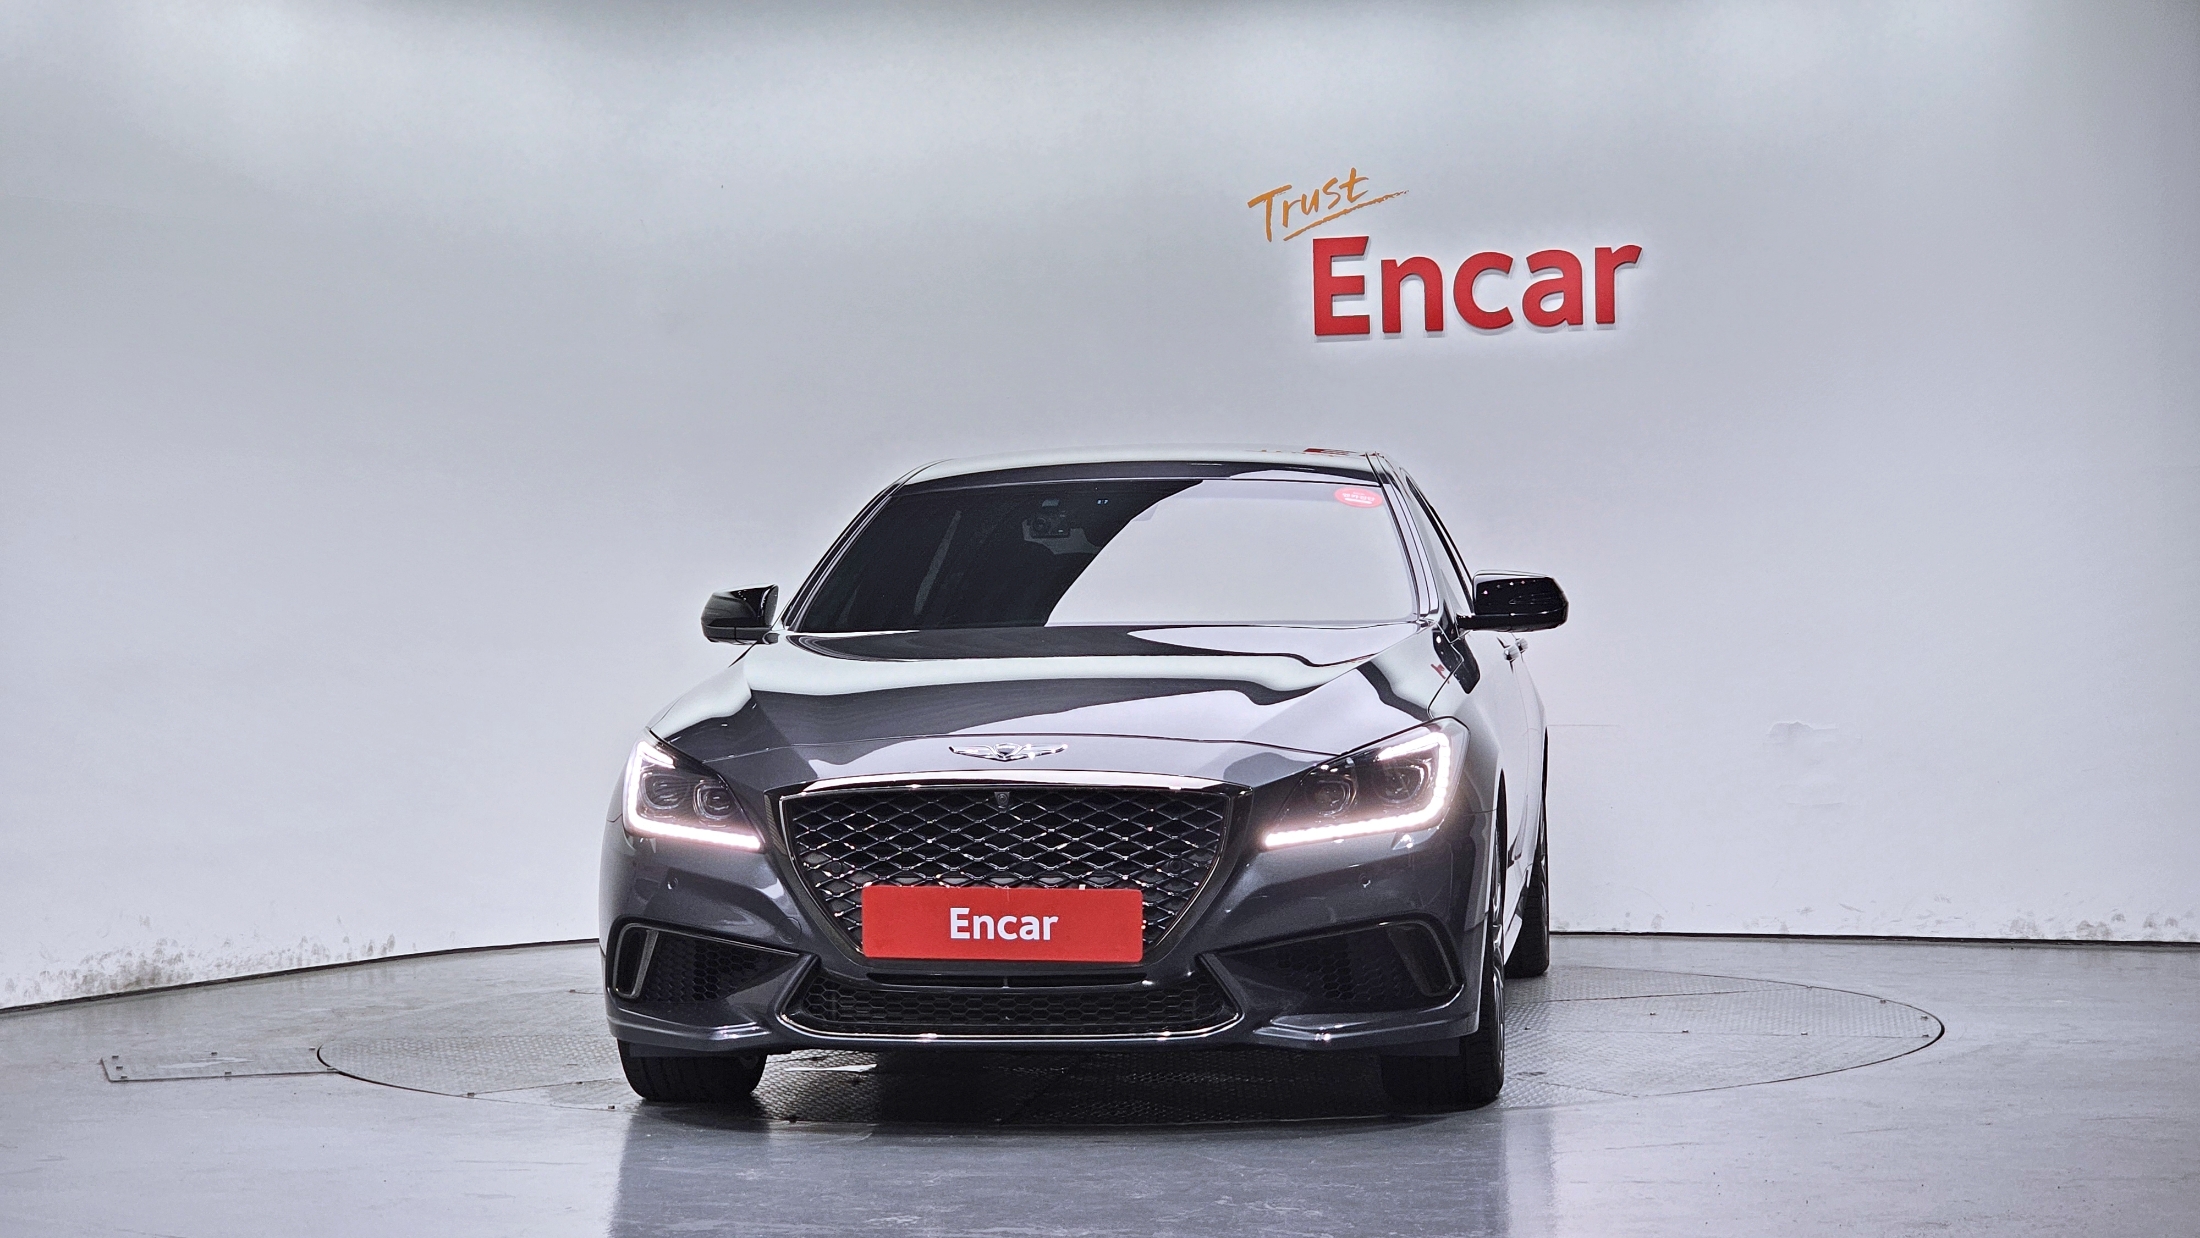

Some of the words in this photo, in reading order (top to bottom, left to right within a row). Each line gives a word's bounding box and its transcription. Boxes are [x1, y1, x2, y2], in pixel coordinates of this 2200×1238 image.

[1247, 167, 1370, 243] Trust
[1312, 235, 1643, 337] Encar
[949, 907, 1059, 941] Encar
